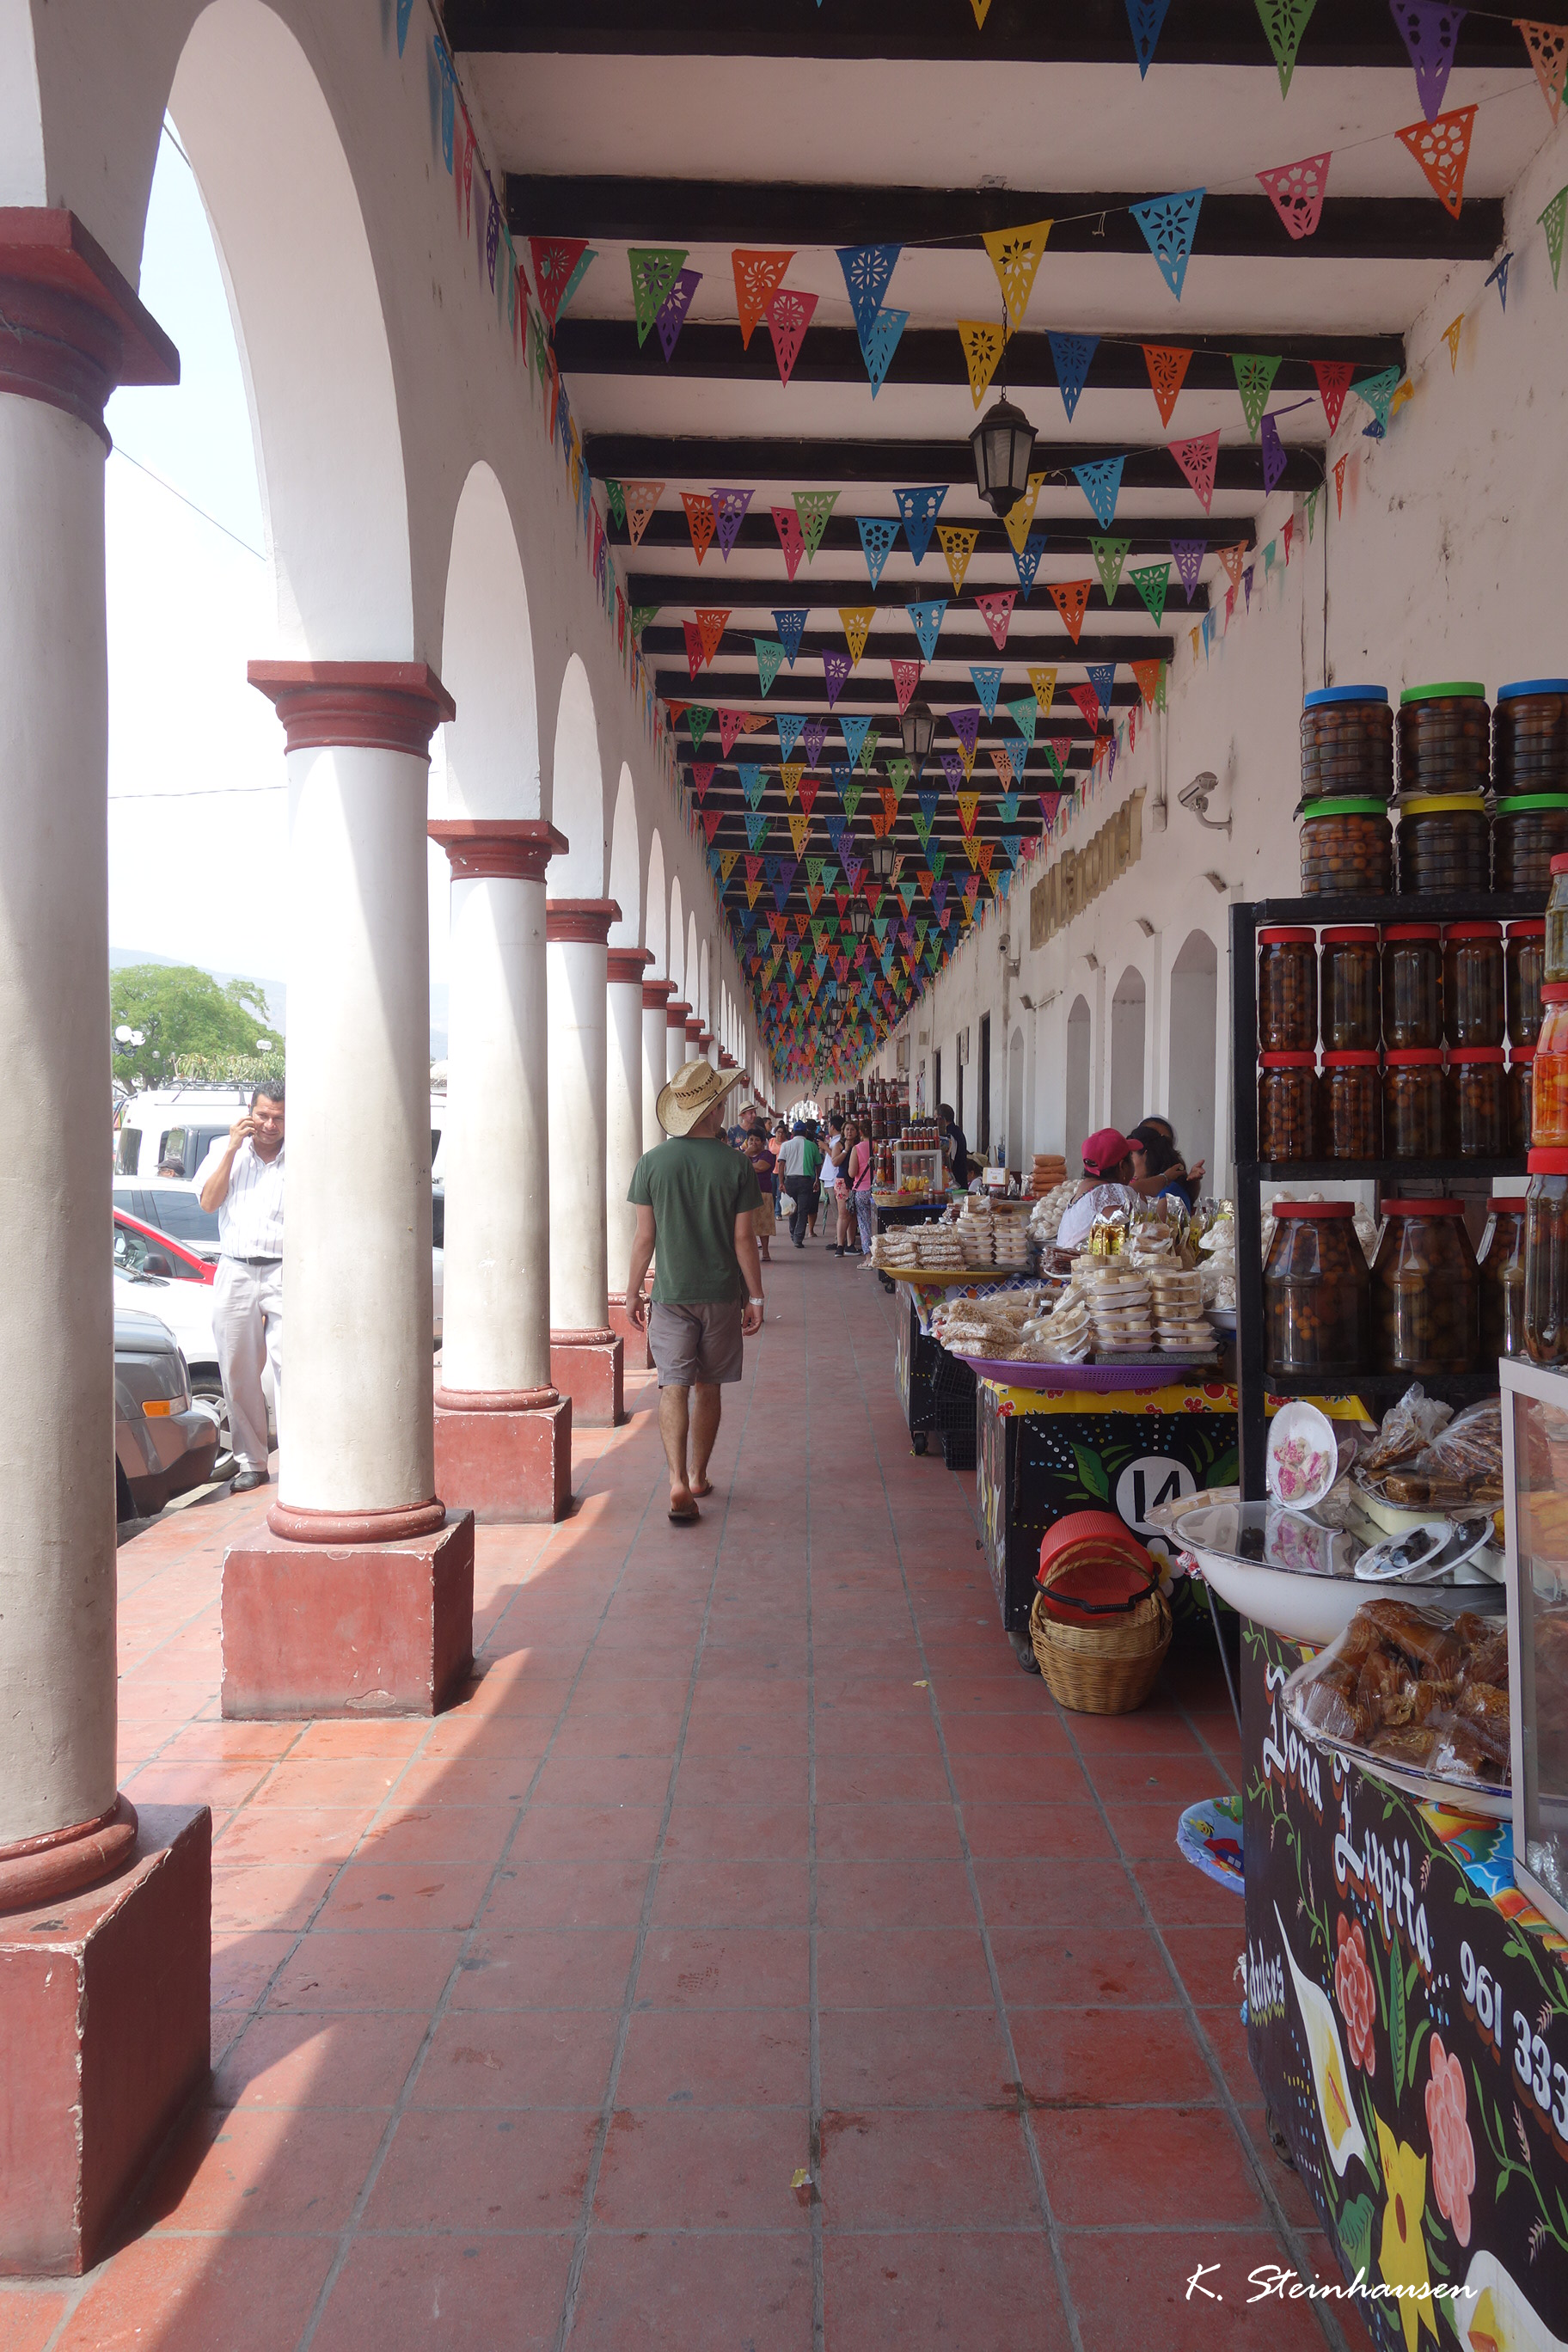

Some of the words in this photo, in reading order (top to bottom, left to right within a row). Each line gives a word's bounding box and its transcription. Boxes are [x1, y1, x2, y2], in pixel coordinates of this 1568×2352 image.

[1133, 1470, 1181, 1523] 14
[1334, 1750, 1432, 1973] Lupita
[1248, 1937, 1284, 2012] dulces
[1461, 1945, 1503, 2049] 961
